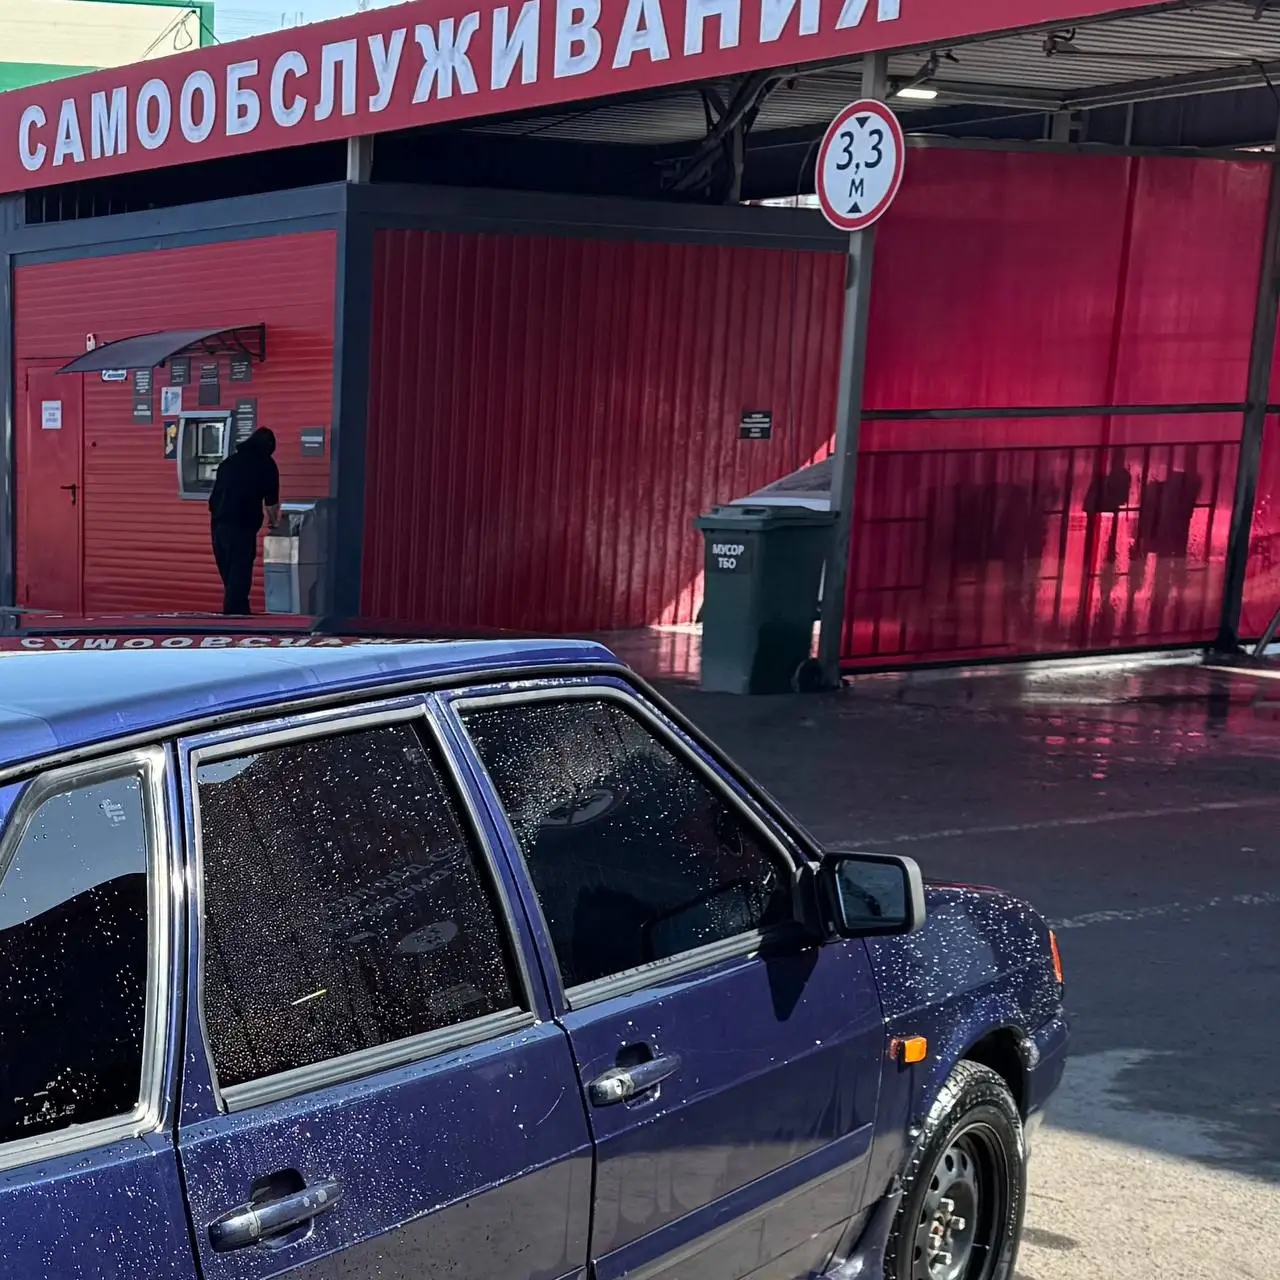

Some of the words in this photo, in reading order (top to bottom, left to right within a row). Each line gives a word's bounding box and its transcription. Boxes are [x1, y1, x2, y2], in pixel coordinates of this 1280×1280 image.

[18, 0, 902, 172] САМООБСЛУЖИВАН
[836, 128, 884, 175] 3,3
[712, 543, 745, 556] МУСОР
[718, 557, 737, 569] ТБО
